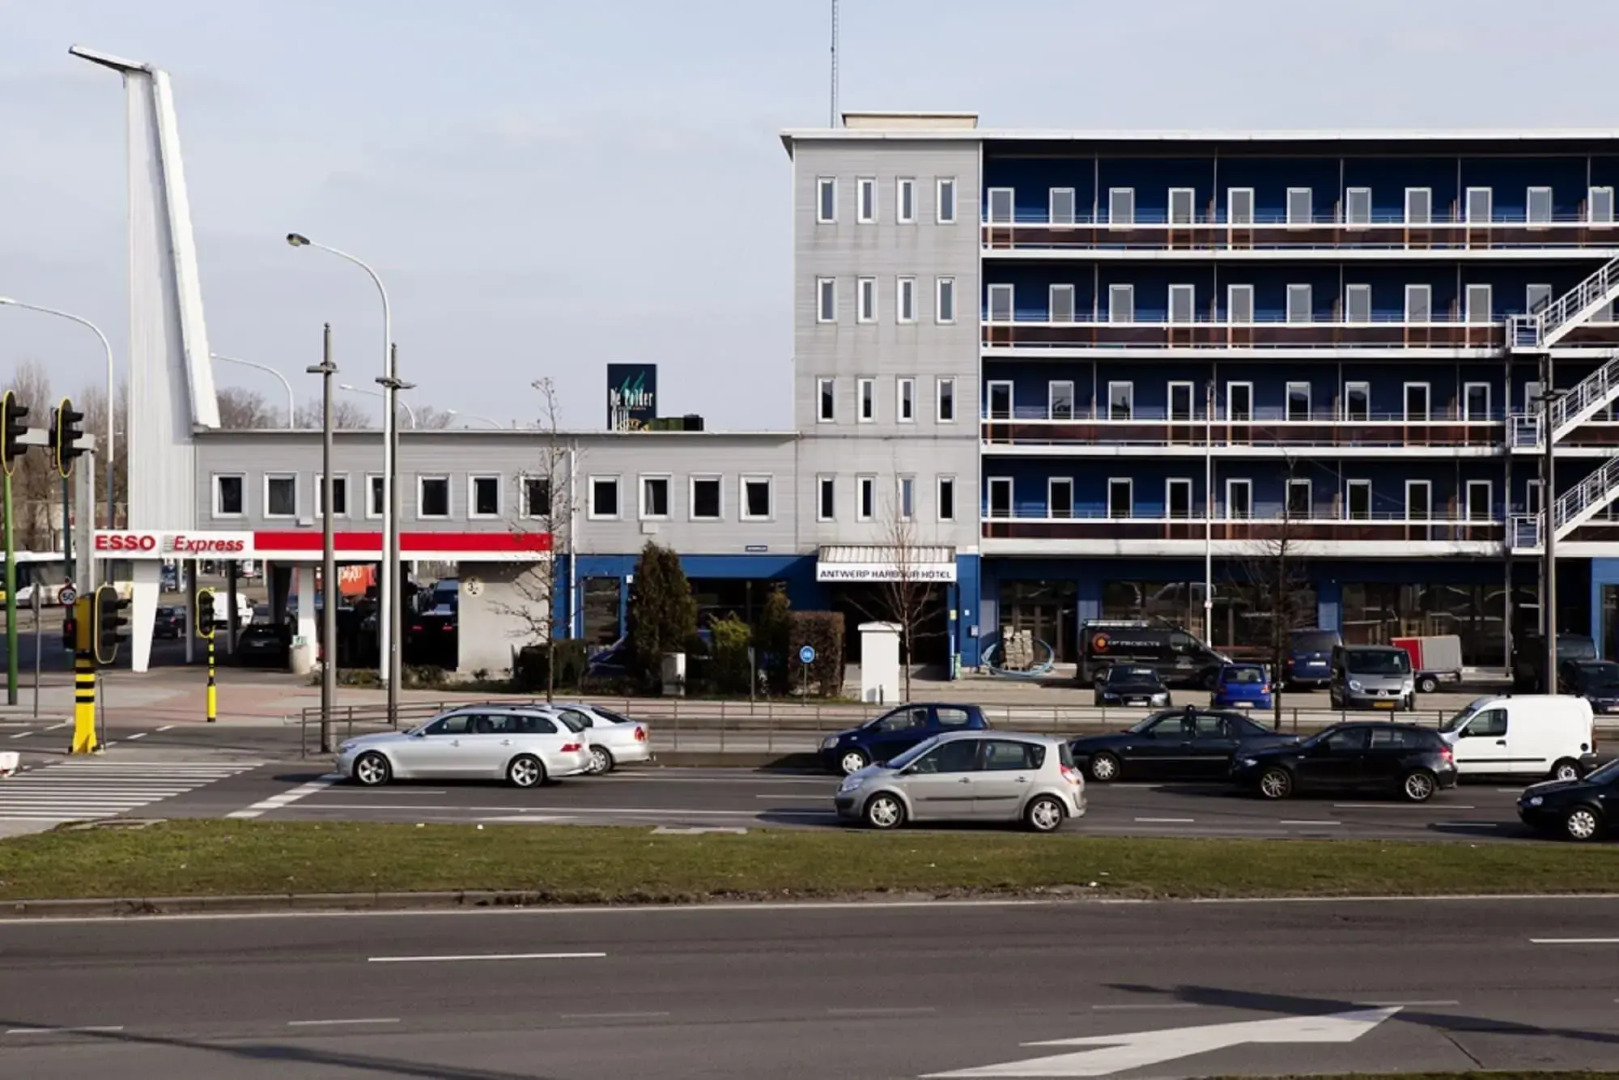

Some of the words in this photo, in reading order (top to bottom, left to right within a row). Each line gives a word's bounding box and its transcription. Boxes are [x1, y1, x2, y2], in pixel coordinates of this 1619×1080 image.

[95, 534, 155, 551] ESSO
[173, 535, 244, 554] Express
[820, 570, 869, 579] ANTWERP
[921, 571, 952, 579] HOTEL
[62, 592, 74, 602] 50
